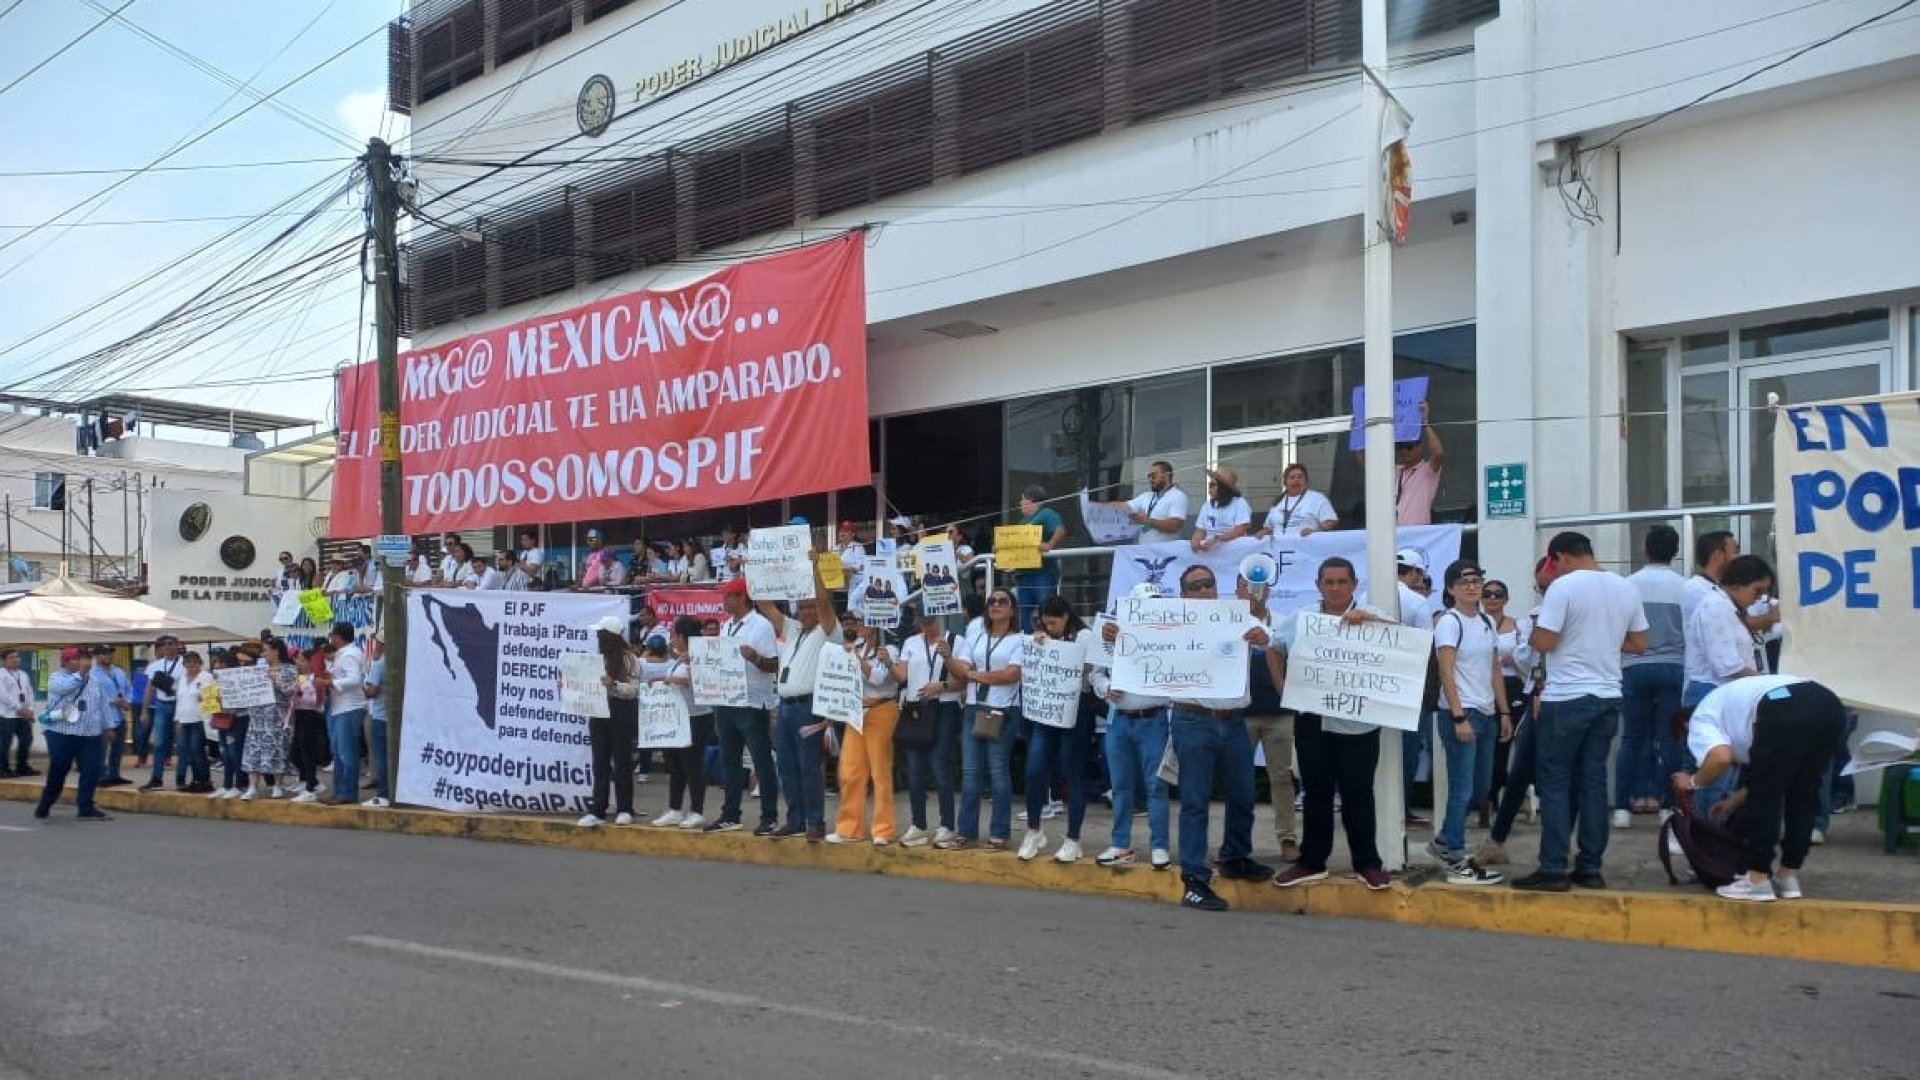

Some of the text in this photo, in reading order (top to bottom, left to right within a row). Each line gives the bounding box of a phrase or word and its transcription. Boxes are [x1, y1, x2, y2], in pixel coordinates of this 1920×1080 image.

[634, 54, 702, 101] PODER
[710, 7, 810, 71] JUDICIAL
[402, 338, 494, 402] MIG@
[367, 419, 441, 458] PDER
[448, 402, 558, 448] JUDICIAL
[563, 393, 599, 430] TE
[609, 384, 647, 424] HA
[656, 342, 841, 418] AMPARADO.
[1787, 402, 1889, 452] EN
[405, 426, 765, 517] TODOSSOMOSPJF
[179, 576, 276, 589] PODER JUDICI
[1798, 548, 1880, 609] DE
[171, 589, 271, 602] DE LA FEDERA
[505, 601, 546, 617] El PJF
[1128, 597, 1198, 626] Respeto
[503, 622, 548, 641] trabaja
[502, 642, 562, 660] defender
[1134, 654, 1212, 685] Poderes
[501, 682, 526, 702] Hoy
[529, 687, 555, 701] nos
[1319, 692, 1369, 717] #PJF
[500, 702, 587, 725] defendernos
[498, 725, 593, 747] para defende
[421, 742, 593, 786] #soypoderjudici
